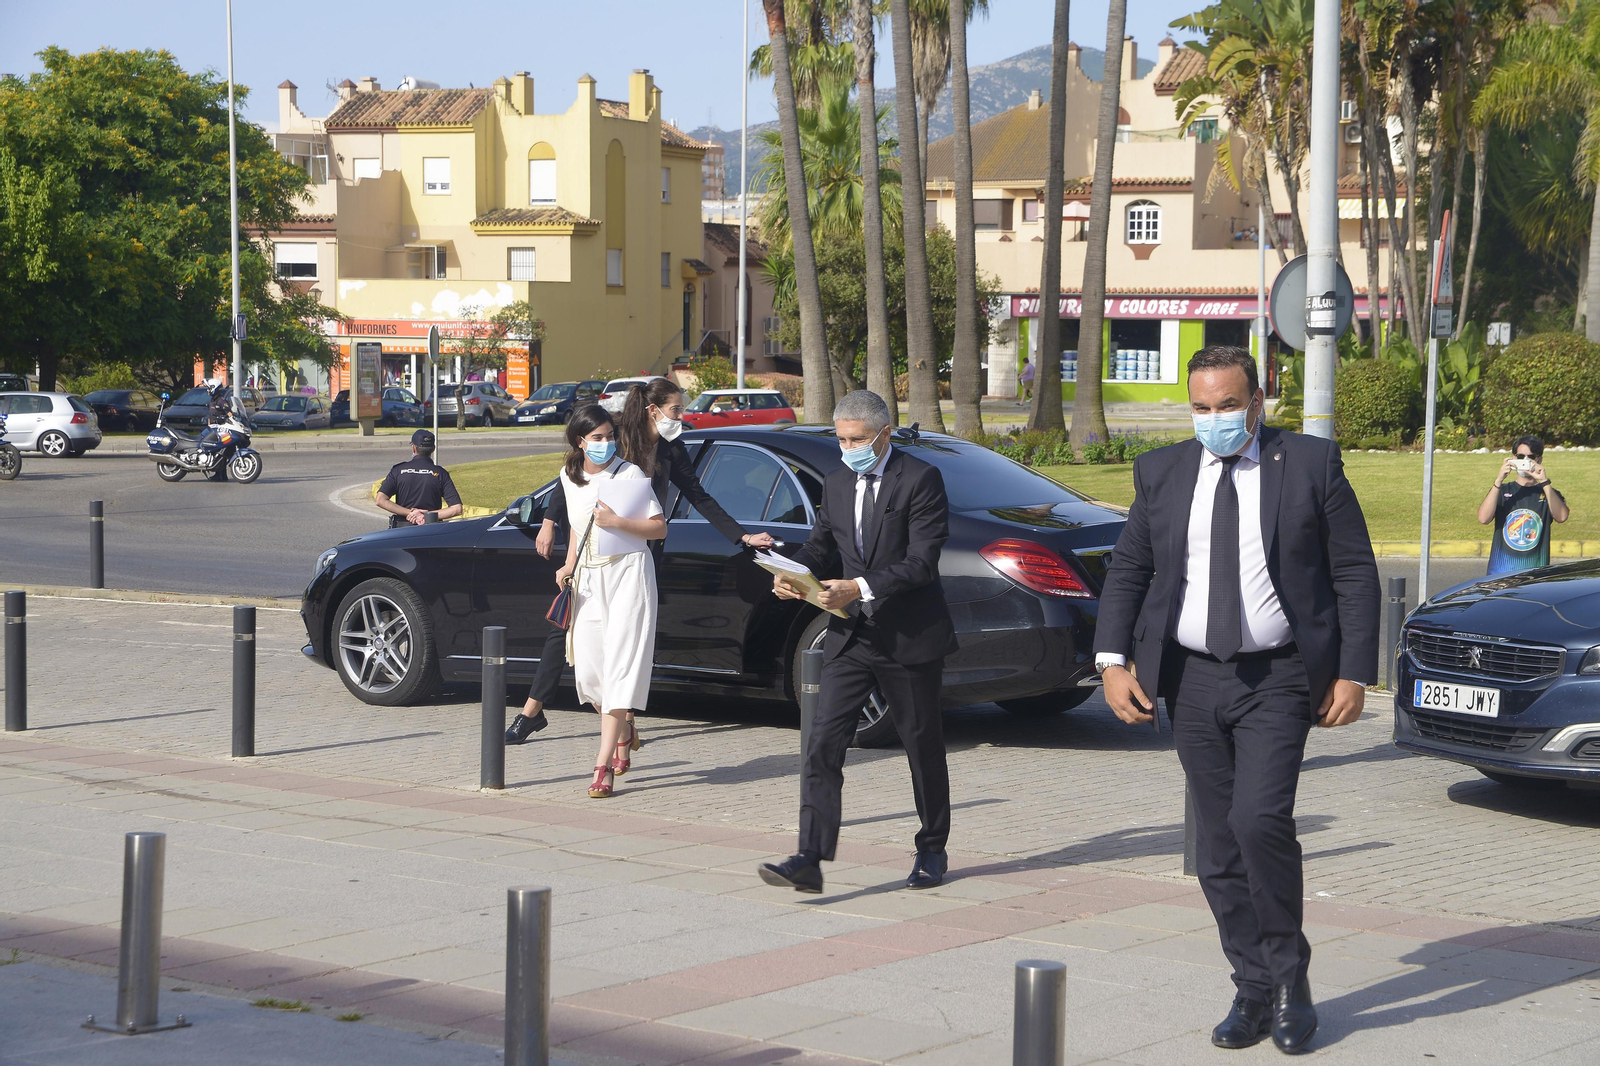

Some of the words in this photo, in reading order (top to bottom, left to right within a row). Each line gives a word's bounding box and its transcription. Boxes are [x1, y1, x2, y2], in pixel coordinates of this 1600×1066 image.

[1119, 299, 1189, 316] COLORES
[1194, 302, 1239, 316] JORGE
[347, 323, 397, 335] UNIFORMES
[1424, 684, 1460, 709] 2851
[1466, 690, 1495, 713] JWY
